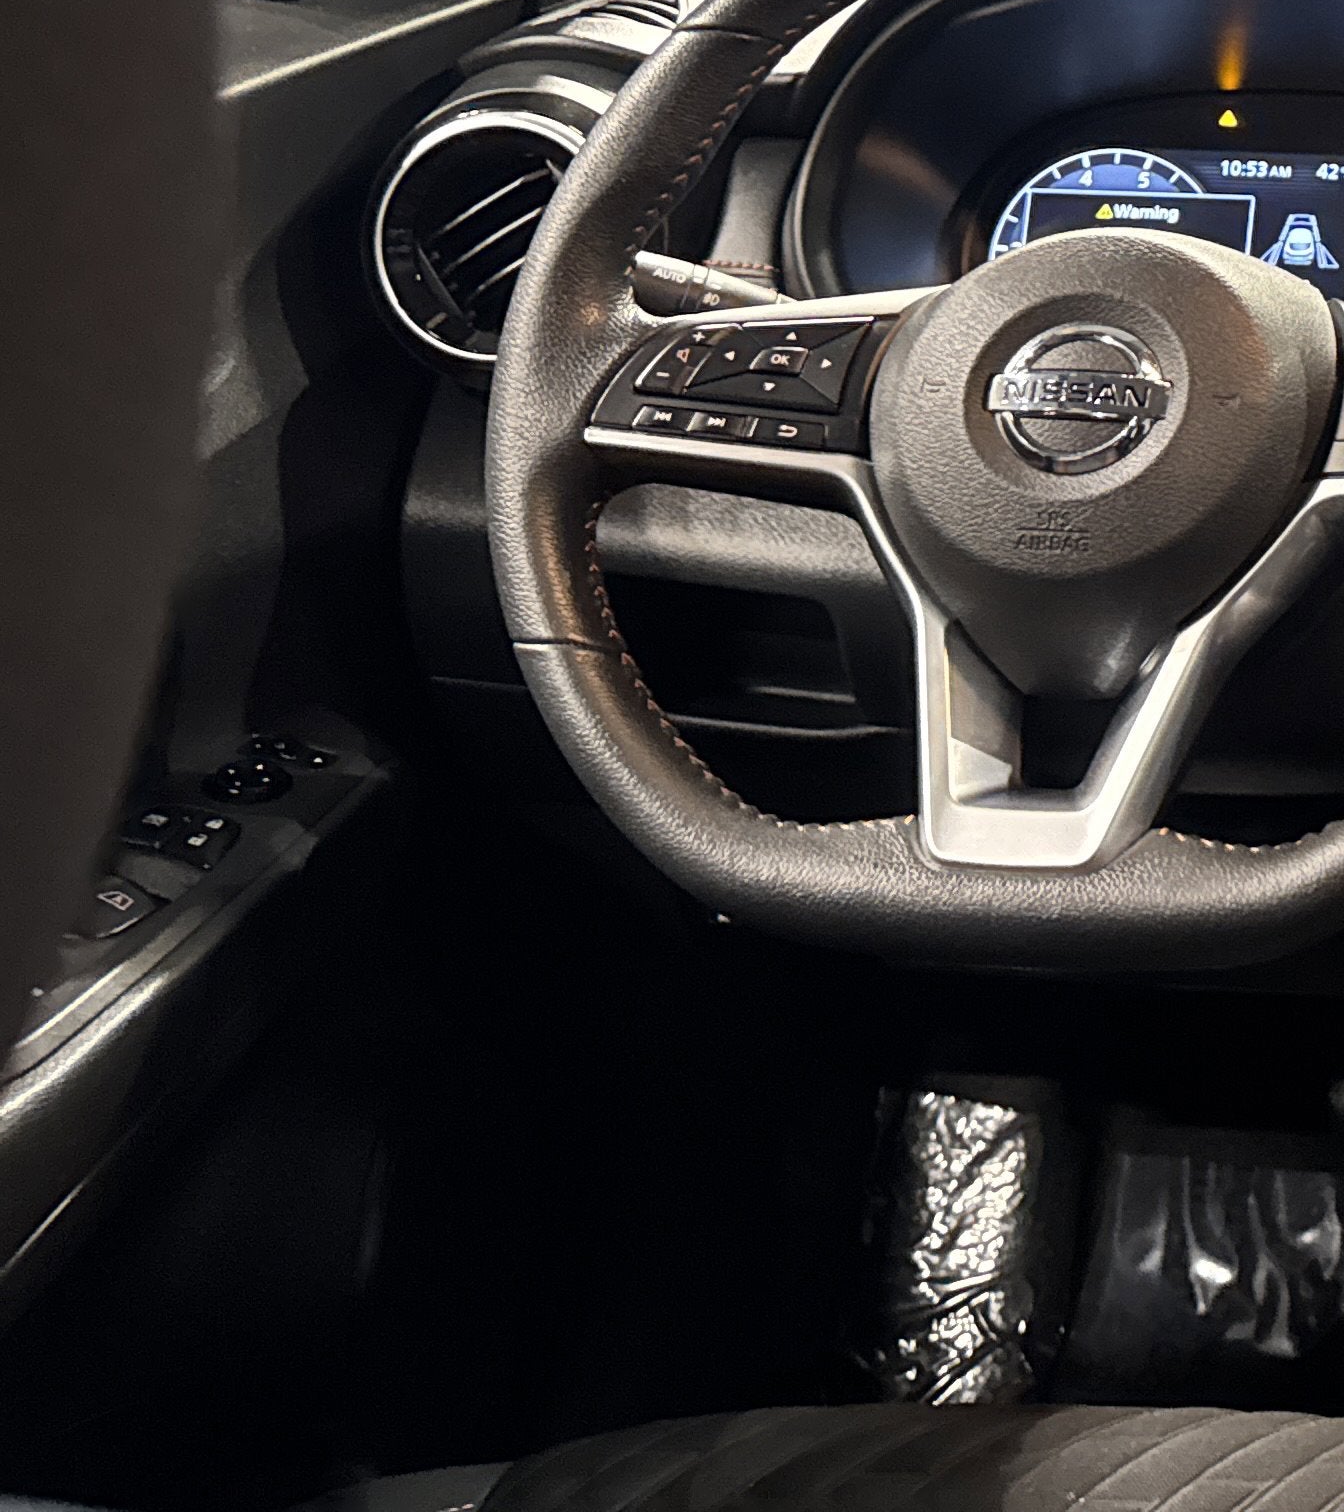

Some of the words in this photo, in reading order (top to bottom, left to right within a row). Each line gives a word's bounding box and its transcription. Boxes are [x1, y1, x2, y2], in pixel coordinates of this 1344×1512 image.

[1079, 170, 1092, 187] 4
[1137, 171, 1150, 188] 5
[1113, 203, 1179, 224] Warning
[653, 267, 687, 284] AUTO
[770, 353, 790, 366] OK
[1001, 376, 1152, 409] NISSAN
